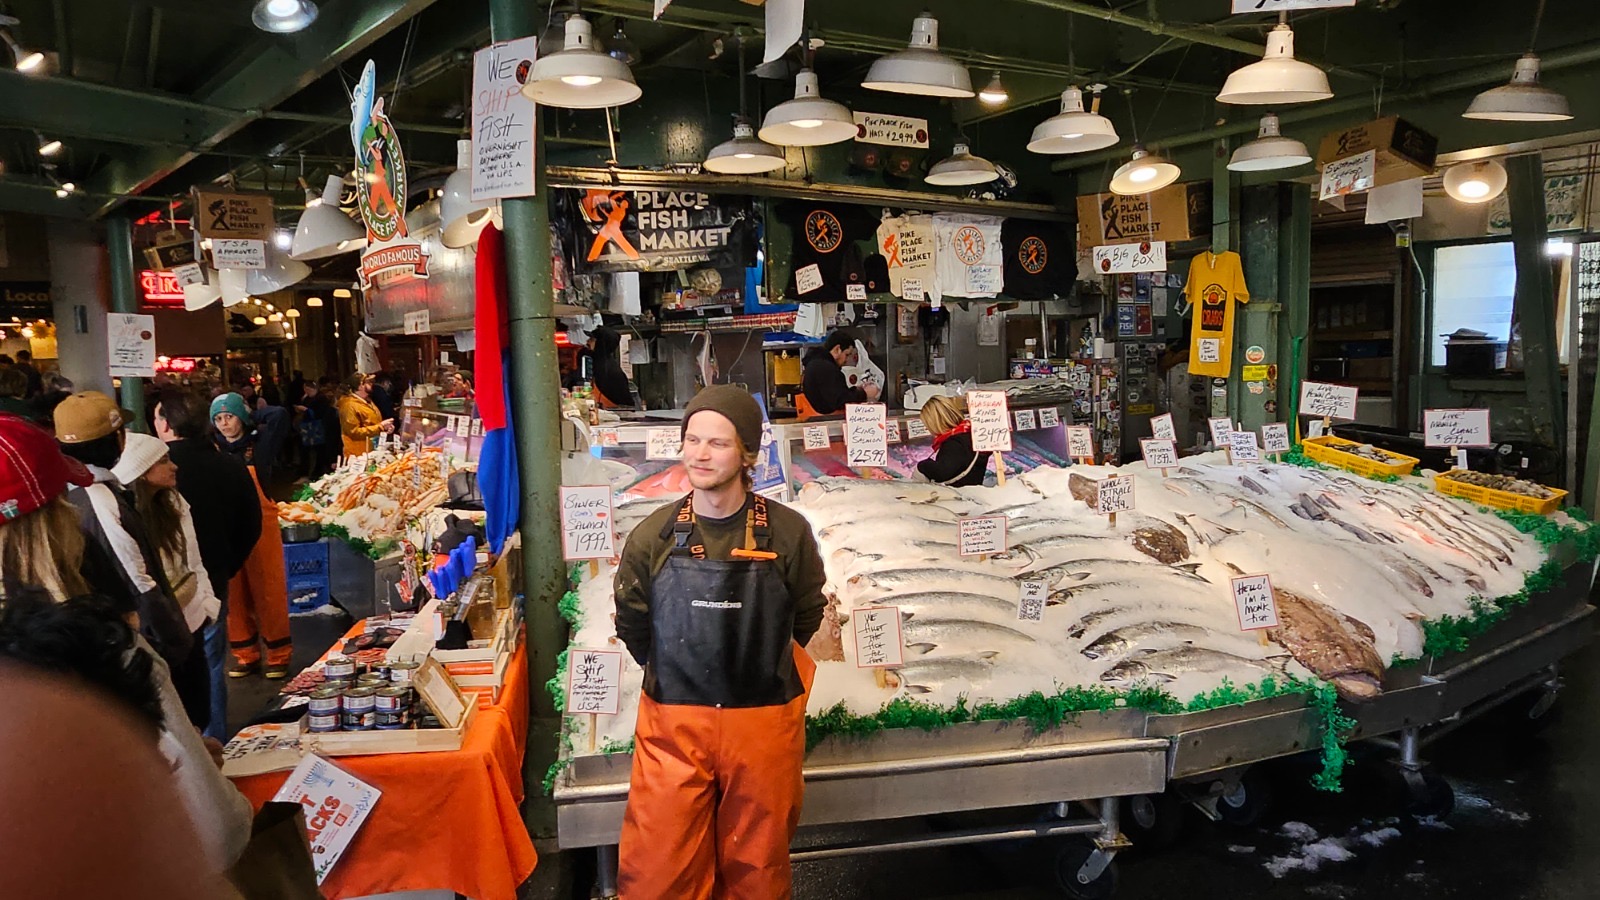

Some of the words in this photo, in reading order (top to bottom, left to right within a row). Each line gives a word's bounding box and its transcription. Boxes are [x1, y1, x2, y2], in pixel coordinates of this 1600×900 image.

[488, 54, 518, 82] WE
[475, 86, 522, 116] SHIP
[478, 113, 524, 142] FISH
[899, 121, 913, 129] FISH
[389, 138, 404, 208] MARKET
[637, 191, 710, 209] PLACE
[1121, 202, 1150, 213] PLACE
[638, 208, 689, 230] FISH
[1122, 213, 1142, 224] FISH
[900, 230, 915, 240] PIKE
[1123, 221, 1161, 236] MARKET
[639, 227, 731, 250] MARKET
[901, 237, 923, 247] PLACE
[902, 247, 917, 256] FISH
[902, 252, 931, 264] MARKET
[1095, 248, 1109, 261] THE
[1113, 246, 1129, 262] BIG
[363, 252, 387, 270] WORLD
[387, 247, 420, 263] FAMOUS
[5, 288, 49, 302] Loca
[849, 414, 882, 423] ALASKAN
[970, 415, 1002, 424] SALMON
[853, 426, 876, 436] KING
[852, 435, 883, 444] SALMON
[1101, 477, 1130, 490] WHOLE
[1100, 485, 1132, 499] PETRALE
[564, 493, 609, 510] SILVER
[564, 517, 610, 532] SALMON
[1023, 582, 1044, 590] SCAN
[1237, 578, 1266, 595] HELLO!
[1245, 602, 1272, 616] MONK
[864, 611, 879, 621] WE
[584, 652, 603, 664] WE
[576, 664, 605, 676] SHIP
[573, 675, 608, 684] FISH
[577, 701, 605, 711] USA
[307, 795, 341, 843] ACKS
